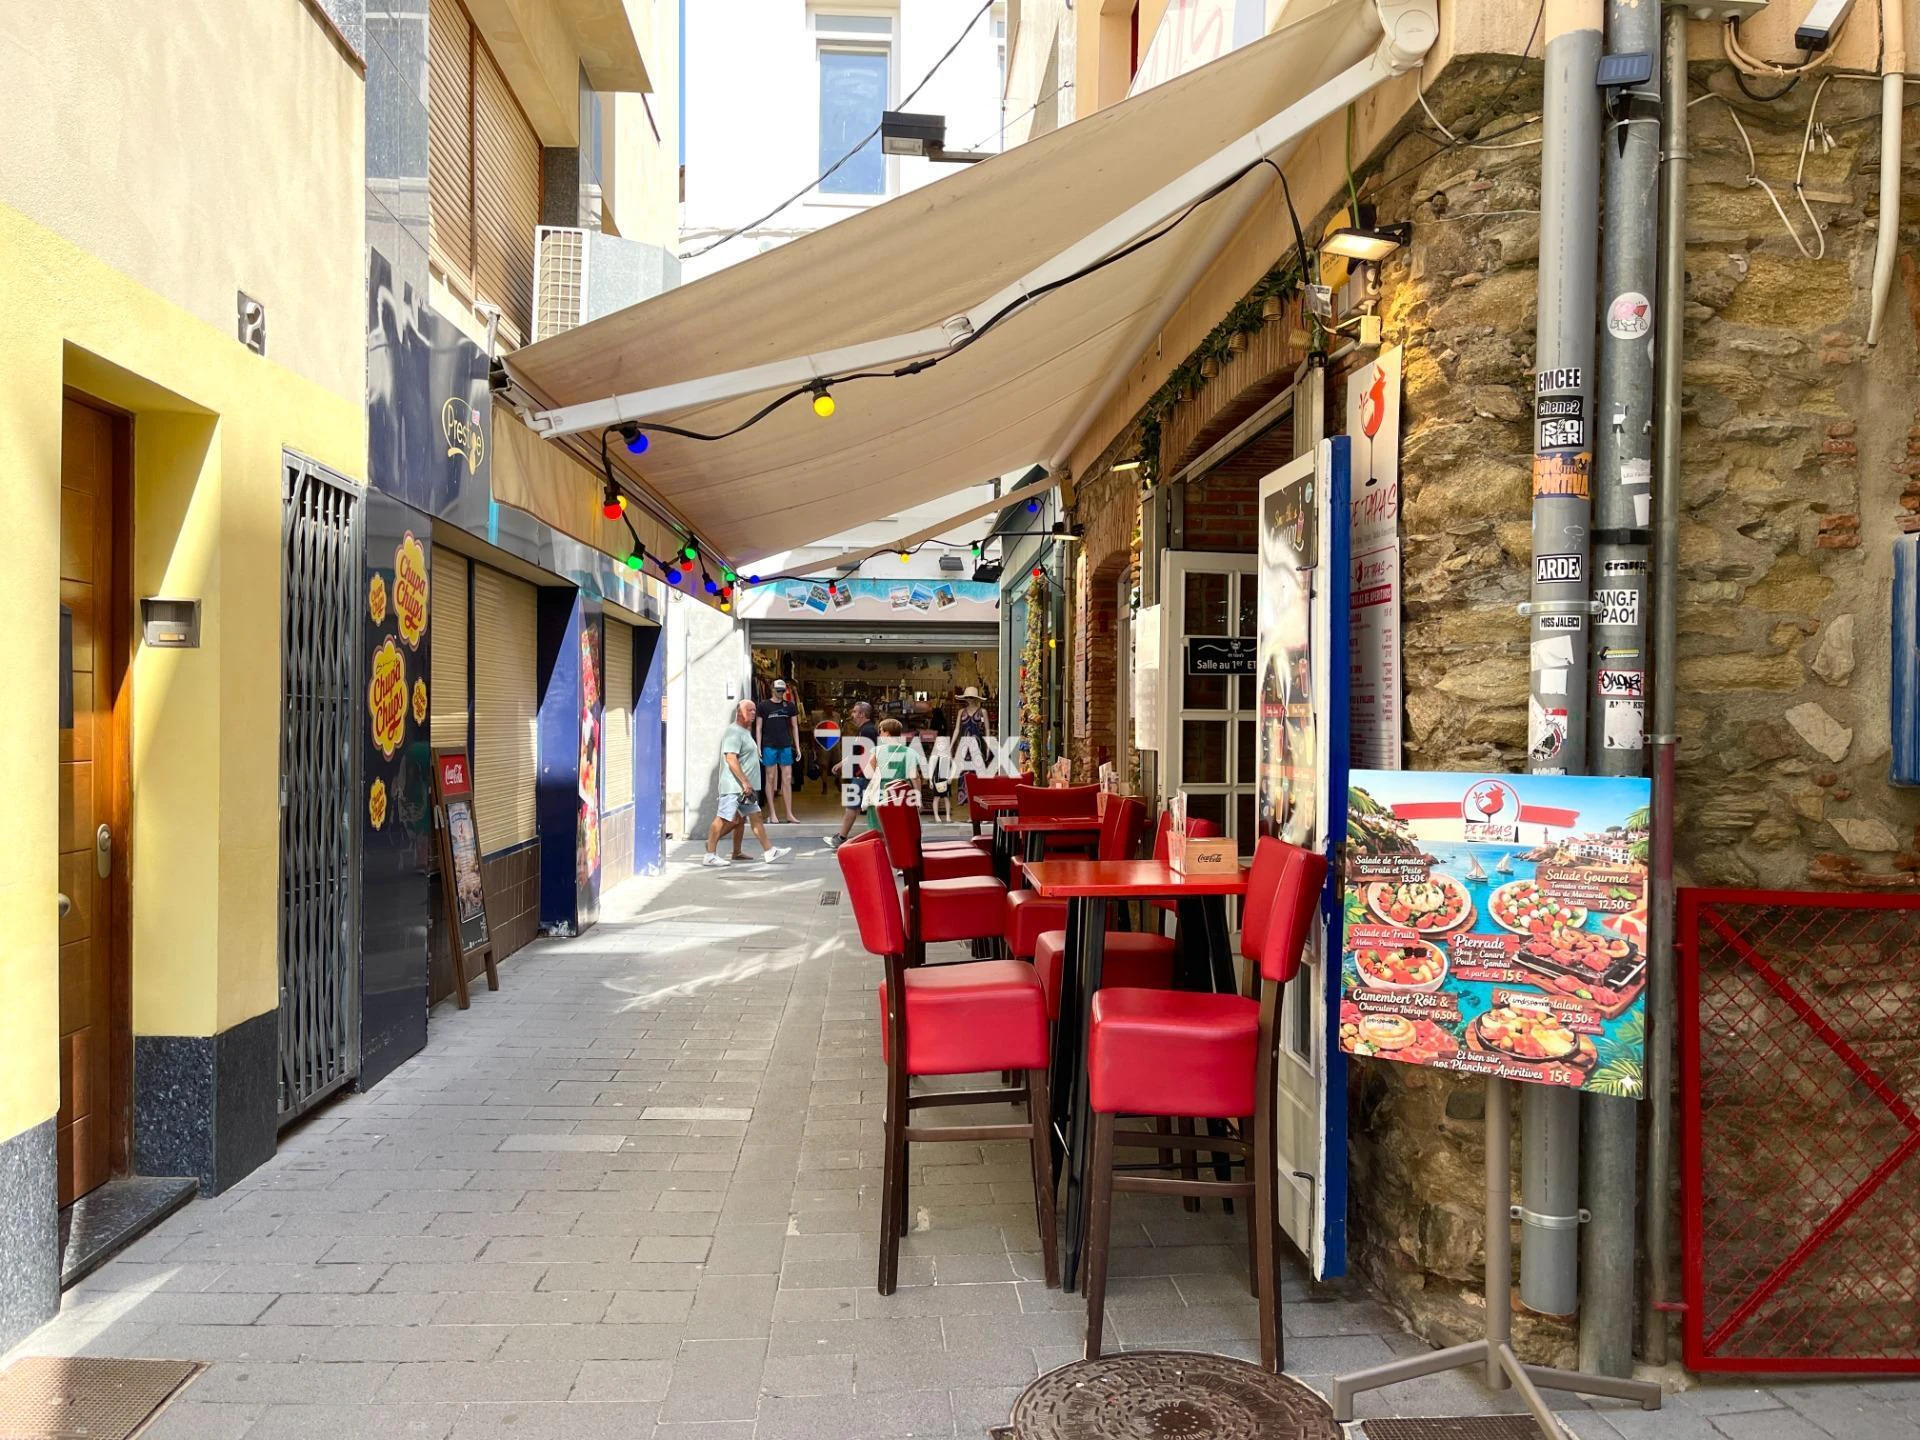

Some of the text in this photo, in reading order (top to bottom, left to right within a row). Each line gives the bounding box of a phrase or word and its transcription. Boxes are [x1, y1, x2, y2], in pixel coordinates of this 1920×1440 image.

[245, 301, 263, 350] 2
[1538, 369, 1580, 392] EMCEE
[1538, 400, 1580, 415] chene2
[1361, 483, 1396, 525] TAPAS
[400, 555, 426, 597] Chupa
[1538, 558, 1576, 580] ARDE
[397, 580, 423, 630] Chups
[1197, 660, 1218, 669] Salle
[1232, 660, 1243, 669] 1er
[1247, 661, 1257, 669] ET
[374, 660, 401, 706] Chupa
[376, 687, 403, 740] Chups
[1355, 855, 1427, 866] Salade de Tomates,
[1360, 865, 1422, 874] Burrata et Pesto
[1544, 869, 1630, 885] Salade Gourmet
[1550, 881, 1576, 889] Tomates
[1563, 898, 1632, 910] Basilic 12,50€
[1353, 927, 1415, 939] Salade de Fruits
[1453, 933, 1505, 949] Pierrade
[1479, 950, 1505, 959] Canard
[1454, 957, 1476, 966] Poulet
[1482, 959, 1511, 969] Gambas
[1353, 988, 1449, 1007] Camembert Rôti &
[1358, 1002, 1458, 1020] Charcuterie Ibérique 16,50€
[1561, 1012, 1594, 1024] 23,50€
[1456, 1050, 1467, 1060] Et
[1467, 1051, 1485, 1062] bien
[1433, 1059, 1572, 1084] nos Planches Apéritives 15€
